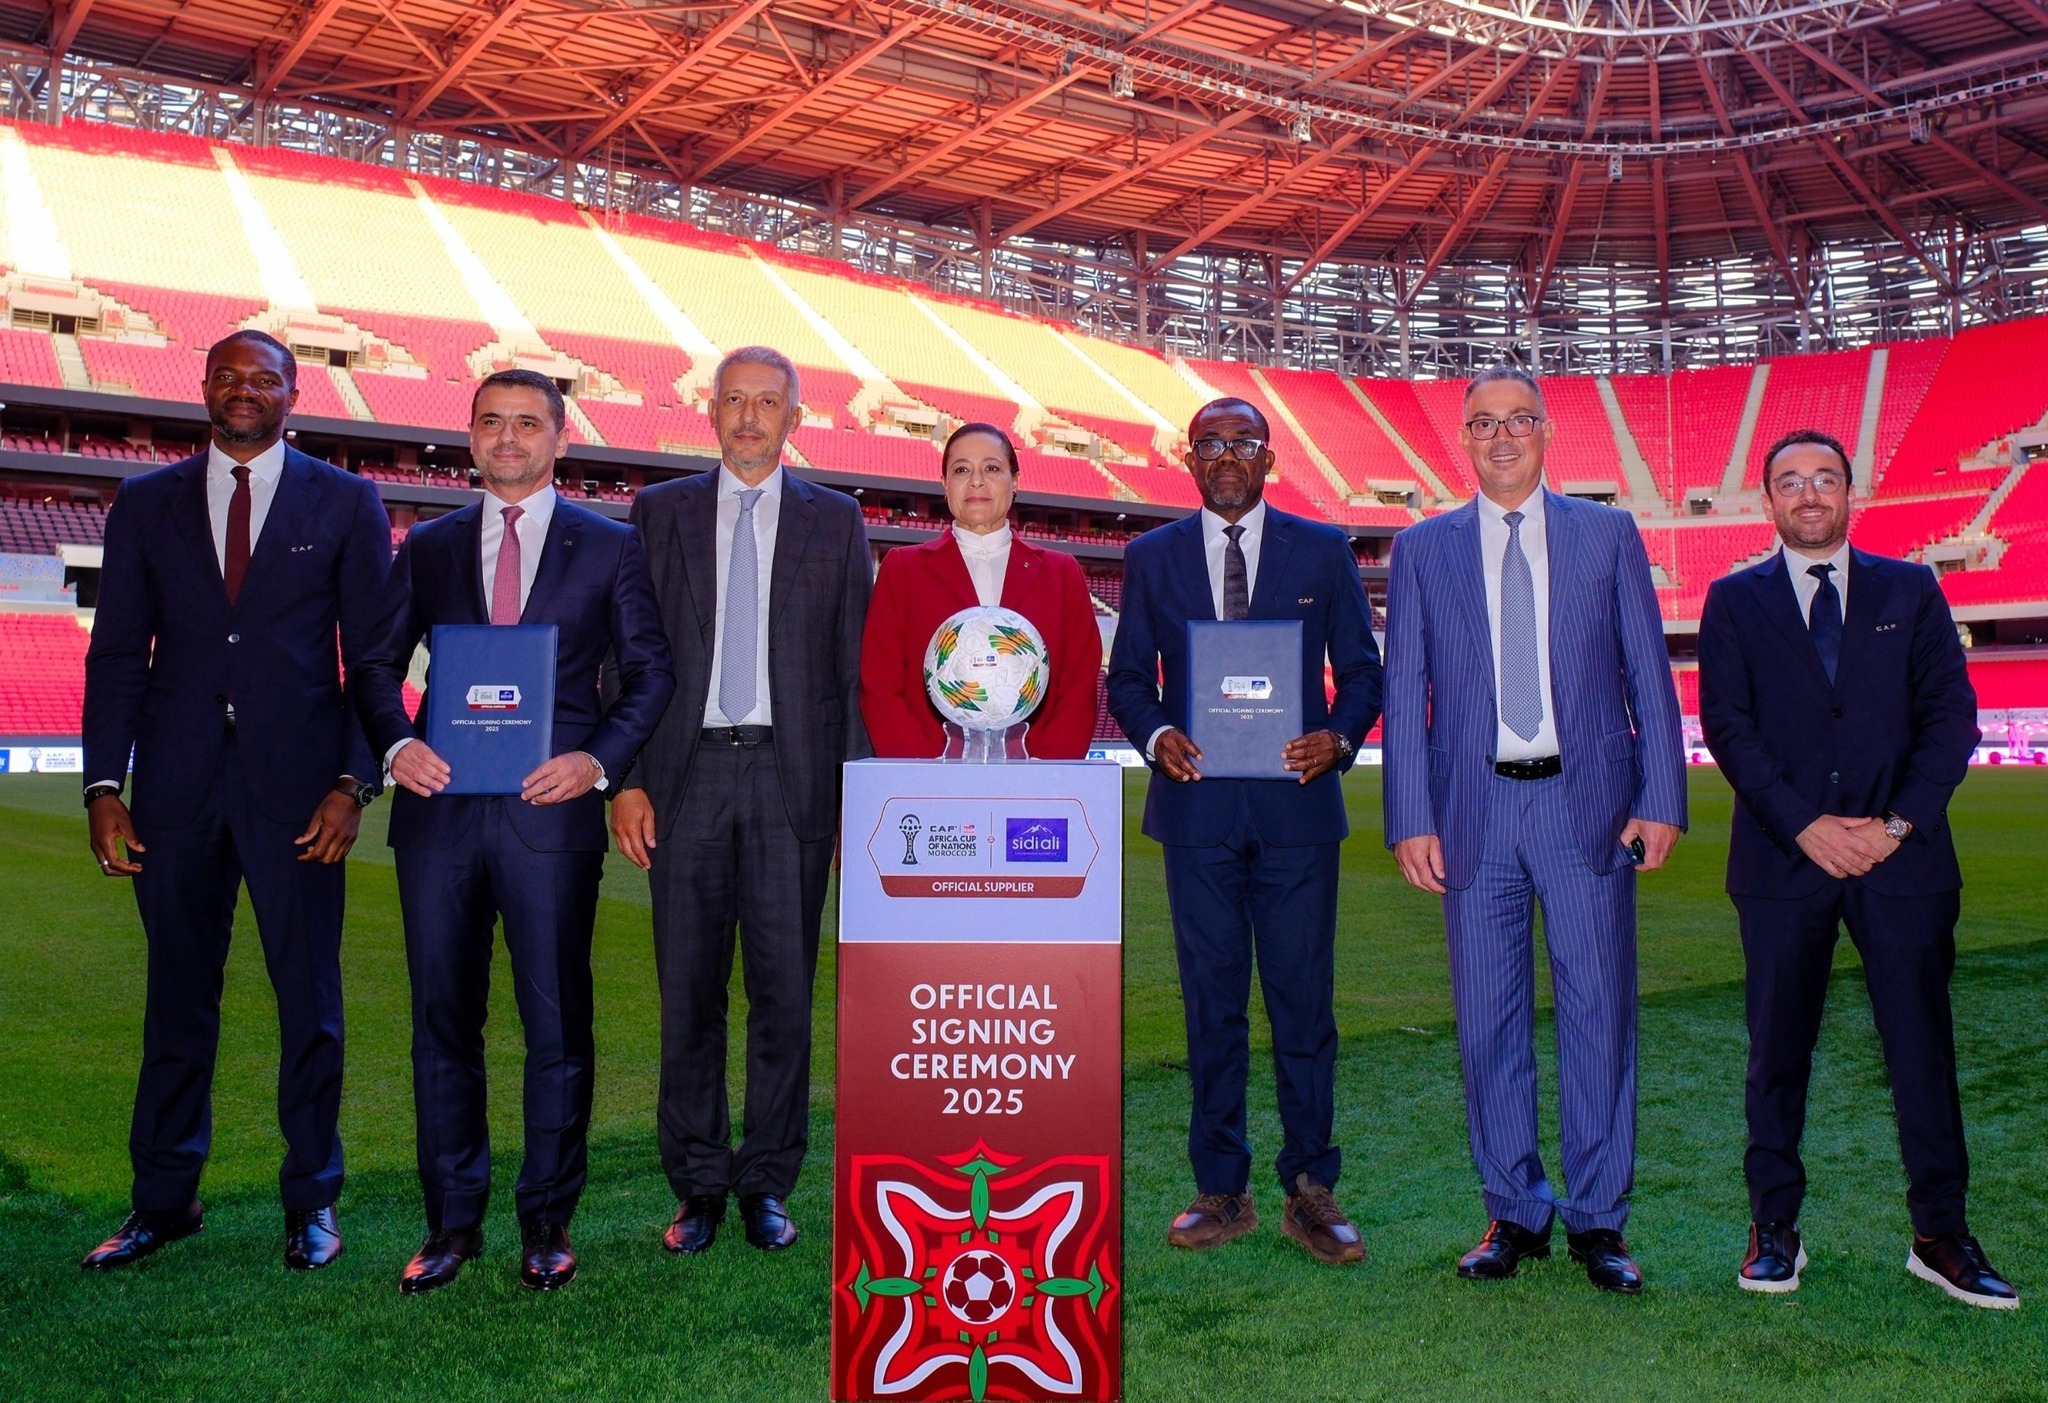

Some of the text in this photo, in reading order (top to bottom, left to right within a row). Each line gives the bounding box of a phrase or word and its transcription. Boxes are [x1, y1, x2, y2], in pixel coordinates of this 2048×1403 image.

[1012, 836, 1059, 850] sidi ali
[931, 881, 1034, 892] OFFICIAL SUPPLIER
[910, 983, 1058, 1010] OFFICIAL
[911, 1018, 1056, 1045] SIGNING
[890, 1053, 1076, 1080] CEREMONY
[941, 1087, 1024, 1115] 2025
